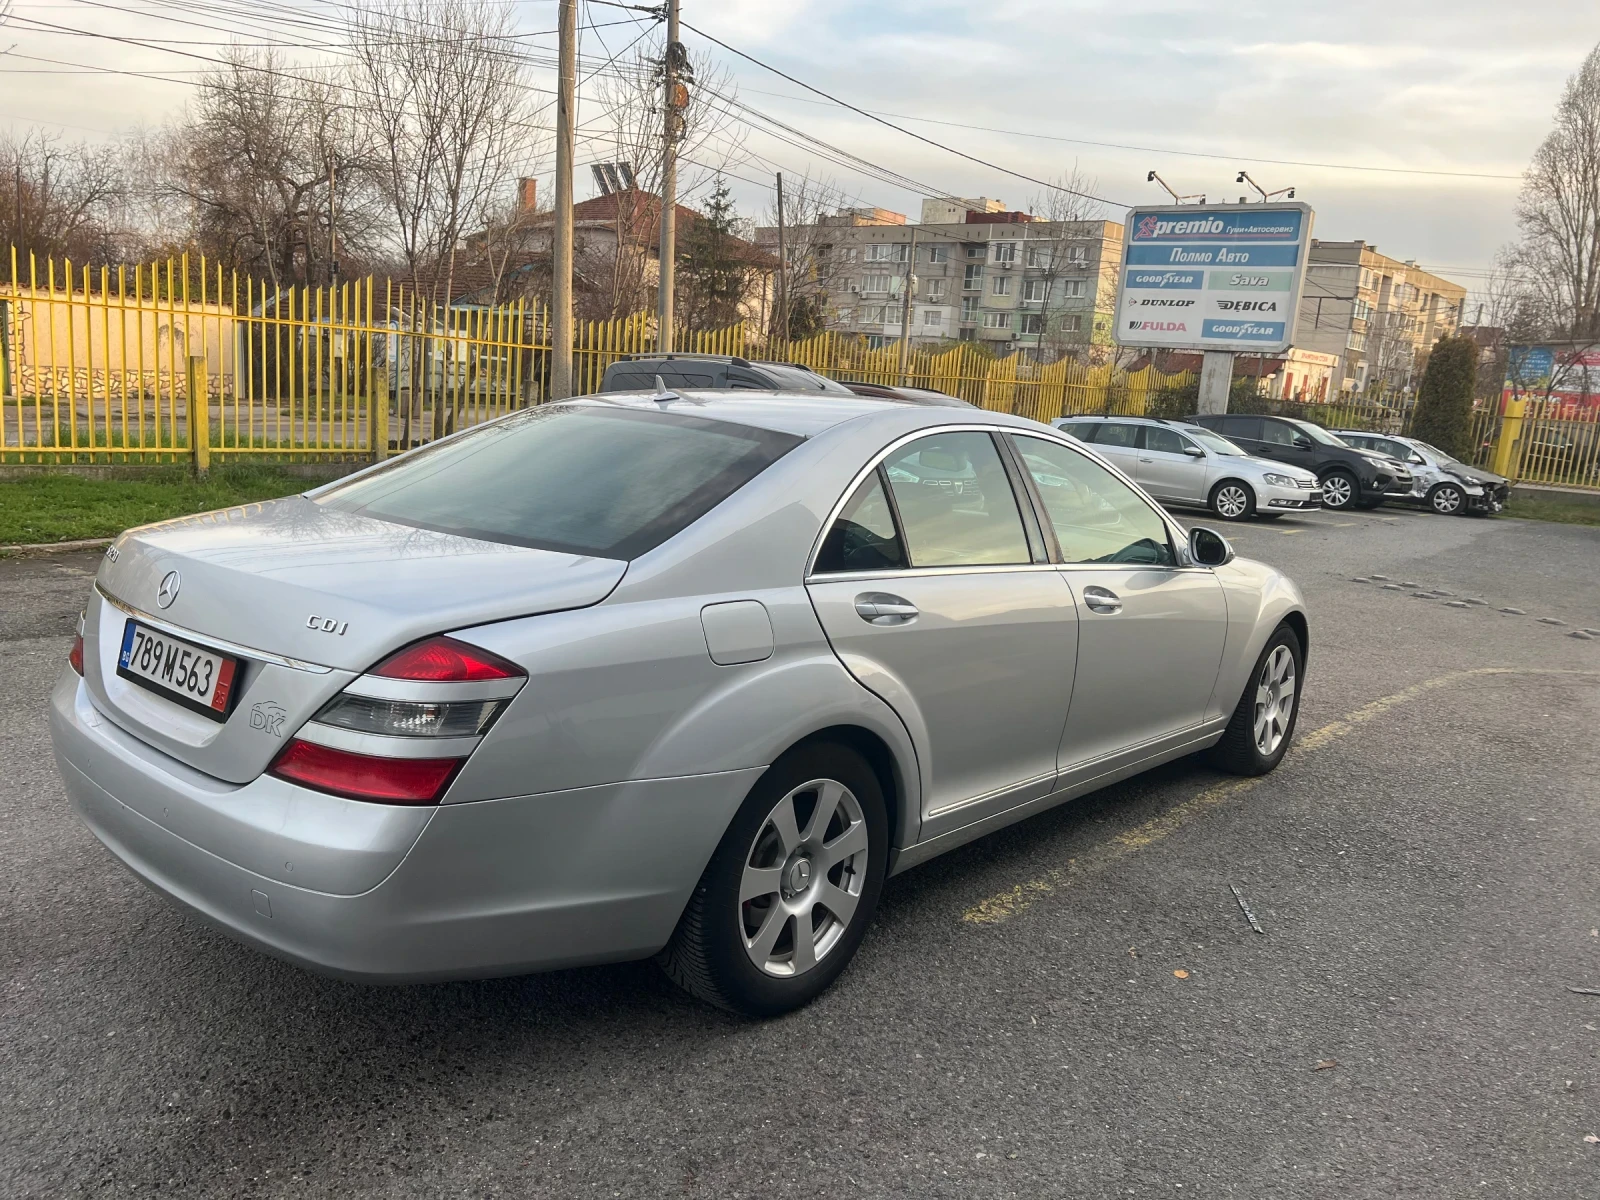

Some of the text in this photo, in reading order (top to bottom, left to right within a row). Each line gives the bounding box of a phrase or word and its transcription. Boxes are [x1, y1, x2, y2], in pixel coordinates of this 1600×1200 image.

[1153, 217, 1224, 238] premio
[1169, 247, 1250, 263] Полмо Авто
[1135, 273, 1194, 286] GOODYEAR
[1229, 274, 1270, 287] Sava
[1140, 299, 1195, 308] DUNLOP
[1140, 321, 1187, 332] FULDA
[1212, 324, 1274, 337] GOODYEAR
[306, 614, 349, 636] CDI
[130, 631, 213, 697] 789M563
[249, 708, 286, 738] DK
